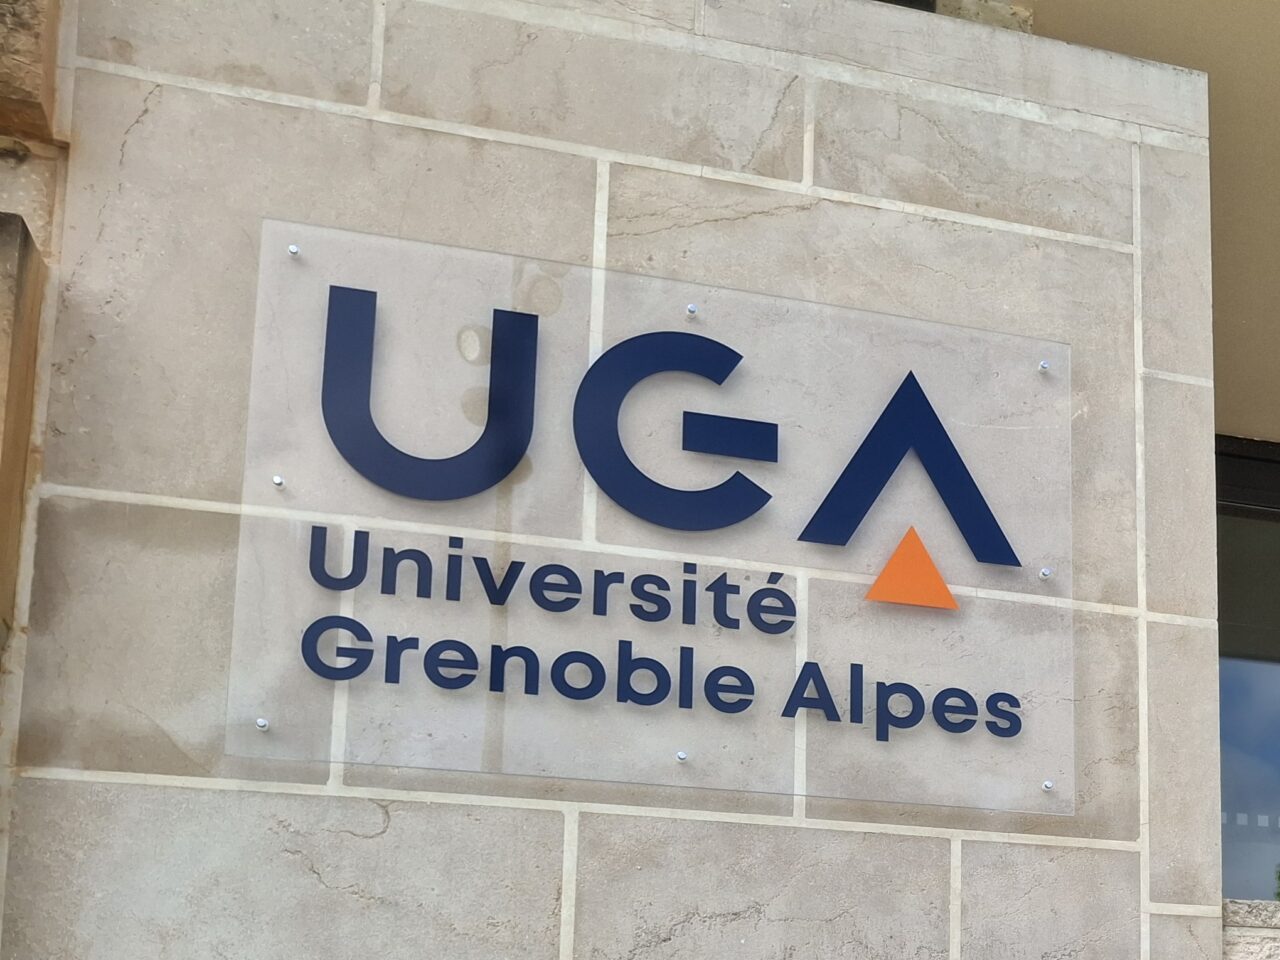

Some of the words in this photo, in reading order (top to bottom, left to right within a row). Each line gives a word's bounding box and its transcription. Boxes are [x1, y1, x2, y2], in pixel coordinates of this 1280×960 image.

[321, 285, 1022, 568] UGA
[309, 525, 798, 636] Université
[301, 614, 755, 715] Grenoble
[781, 662, 1024, 742] Alpes
